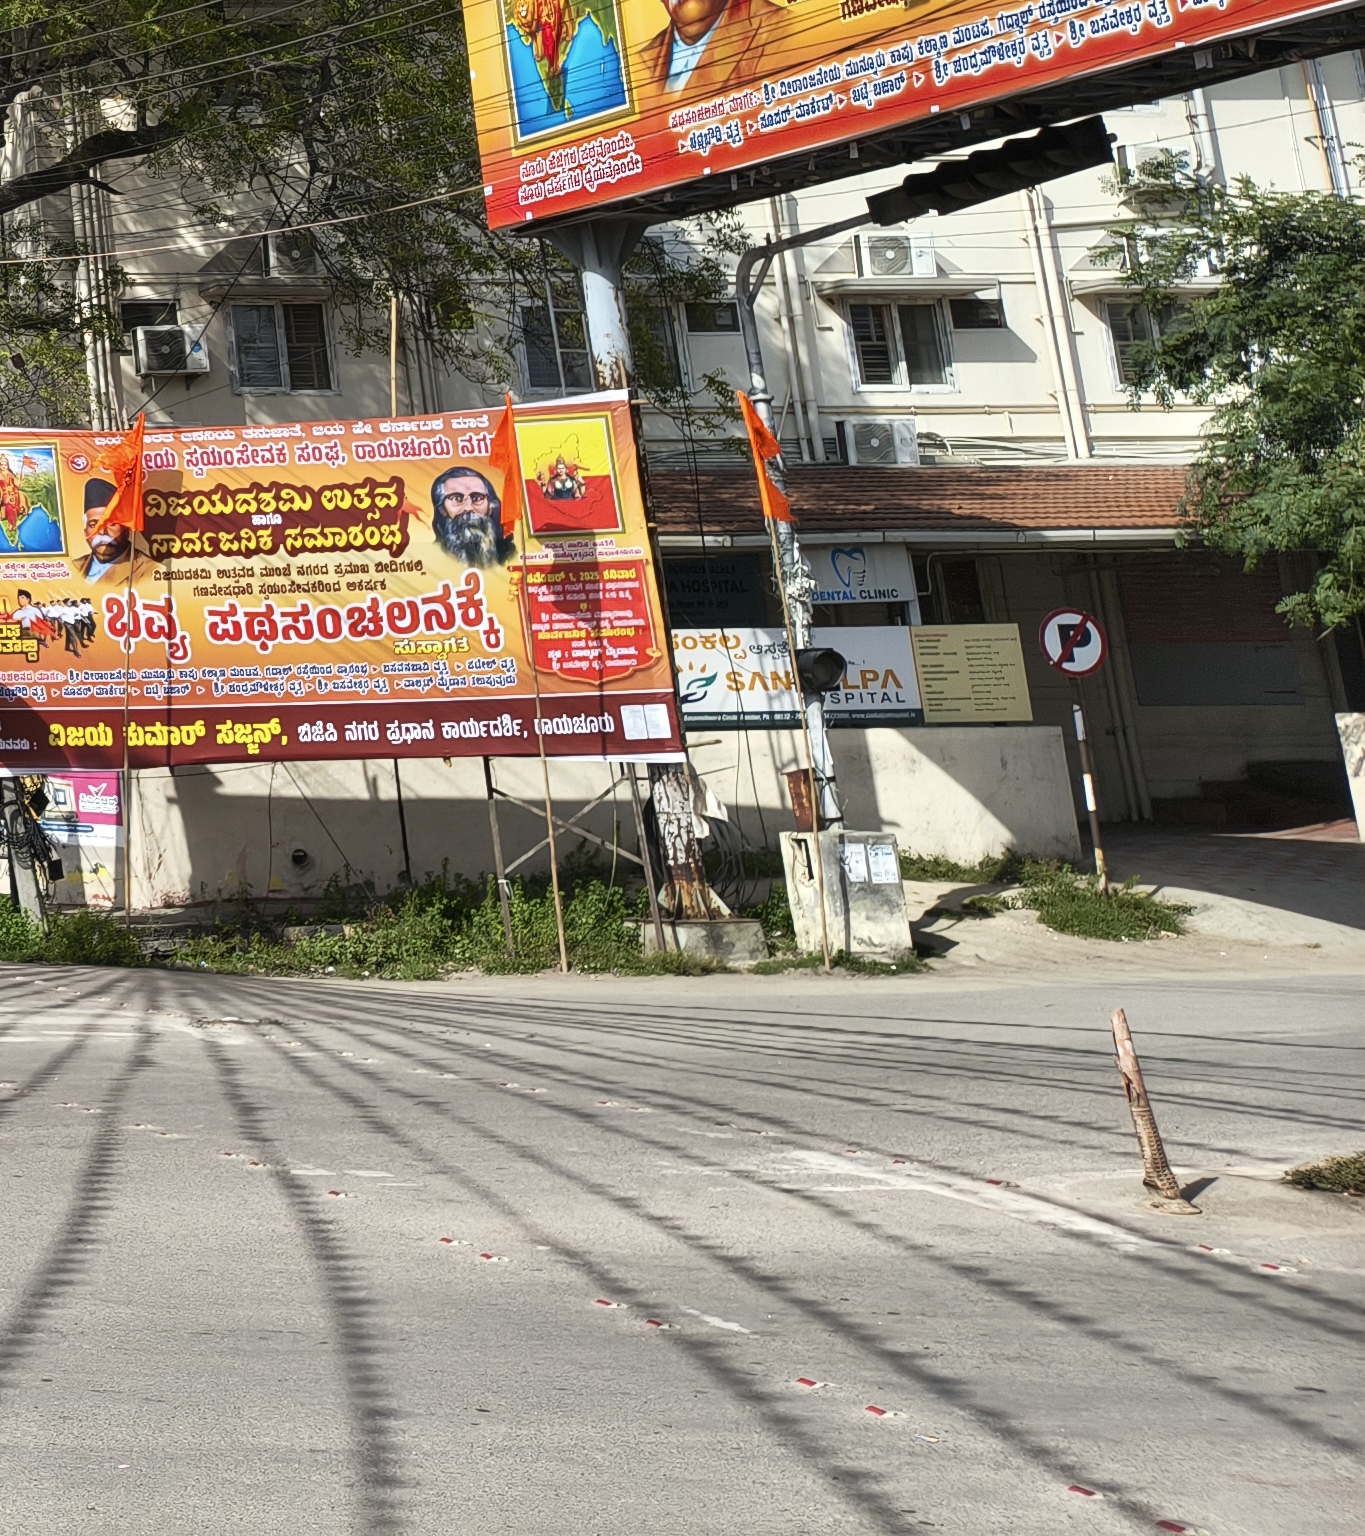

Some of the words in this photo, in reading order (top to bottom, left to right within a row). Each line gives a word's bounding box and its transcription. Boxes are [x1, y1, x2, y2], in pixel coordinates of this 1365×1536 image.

[185, 443, 288, 478] ಸ್ವಯಂಸೇವಕ
[352, 434, 453, 462] ರಾಯಚೂರು
[145, 486, 313, 518] ವಿಜಯದಶಮಿ
[321, 482, 399, 519] ಉತ್ಸವ
[251, 511, 283, 526] ಹಾಗೂ
[150, 524, 272, 558] ಸಾರ್ವಜನಿಕ
[285, 522, 403, 556] ಸಮಾರಂಭ
[296, 564, 329, 577] ನಗರದ
[334, 562, 369, 577] ಪ್ರಮುಖ
[374, 559, 426, 576] ಬೀದಿಗಳಲ್ಲಿ
[811, 589, 856, 602] DENTAL
[860, 589, 899, 600] CLINIC
[106, 590, 189, 661] ಭವ್ಯ
[207, 571, 503, 652] ಪಥಸಂಚಲನಕ್ಕೆ
[393, 637, 470, 661] ಸುಸ್ವಾಗತ
[49, 721, 113, 747] ವಿಜಯ
[298, 721, 339, 743] ಬಿಜೆಪಿ
[344, 721, 380, 741] ನಗರ
[386, 719, 436, 745] ಪ್ರಧಾನ
[535, 712, 615, 737] ರಾಯಚೂರು
